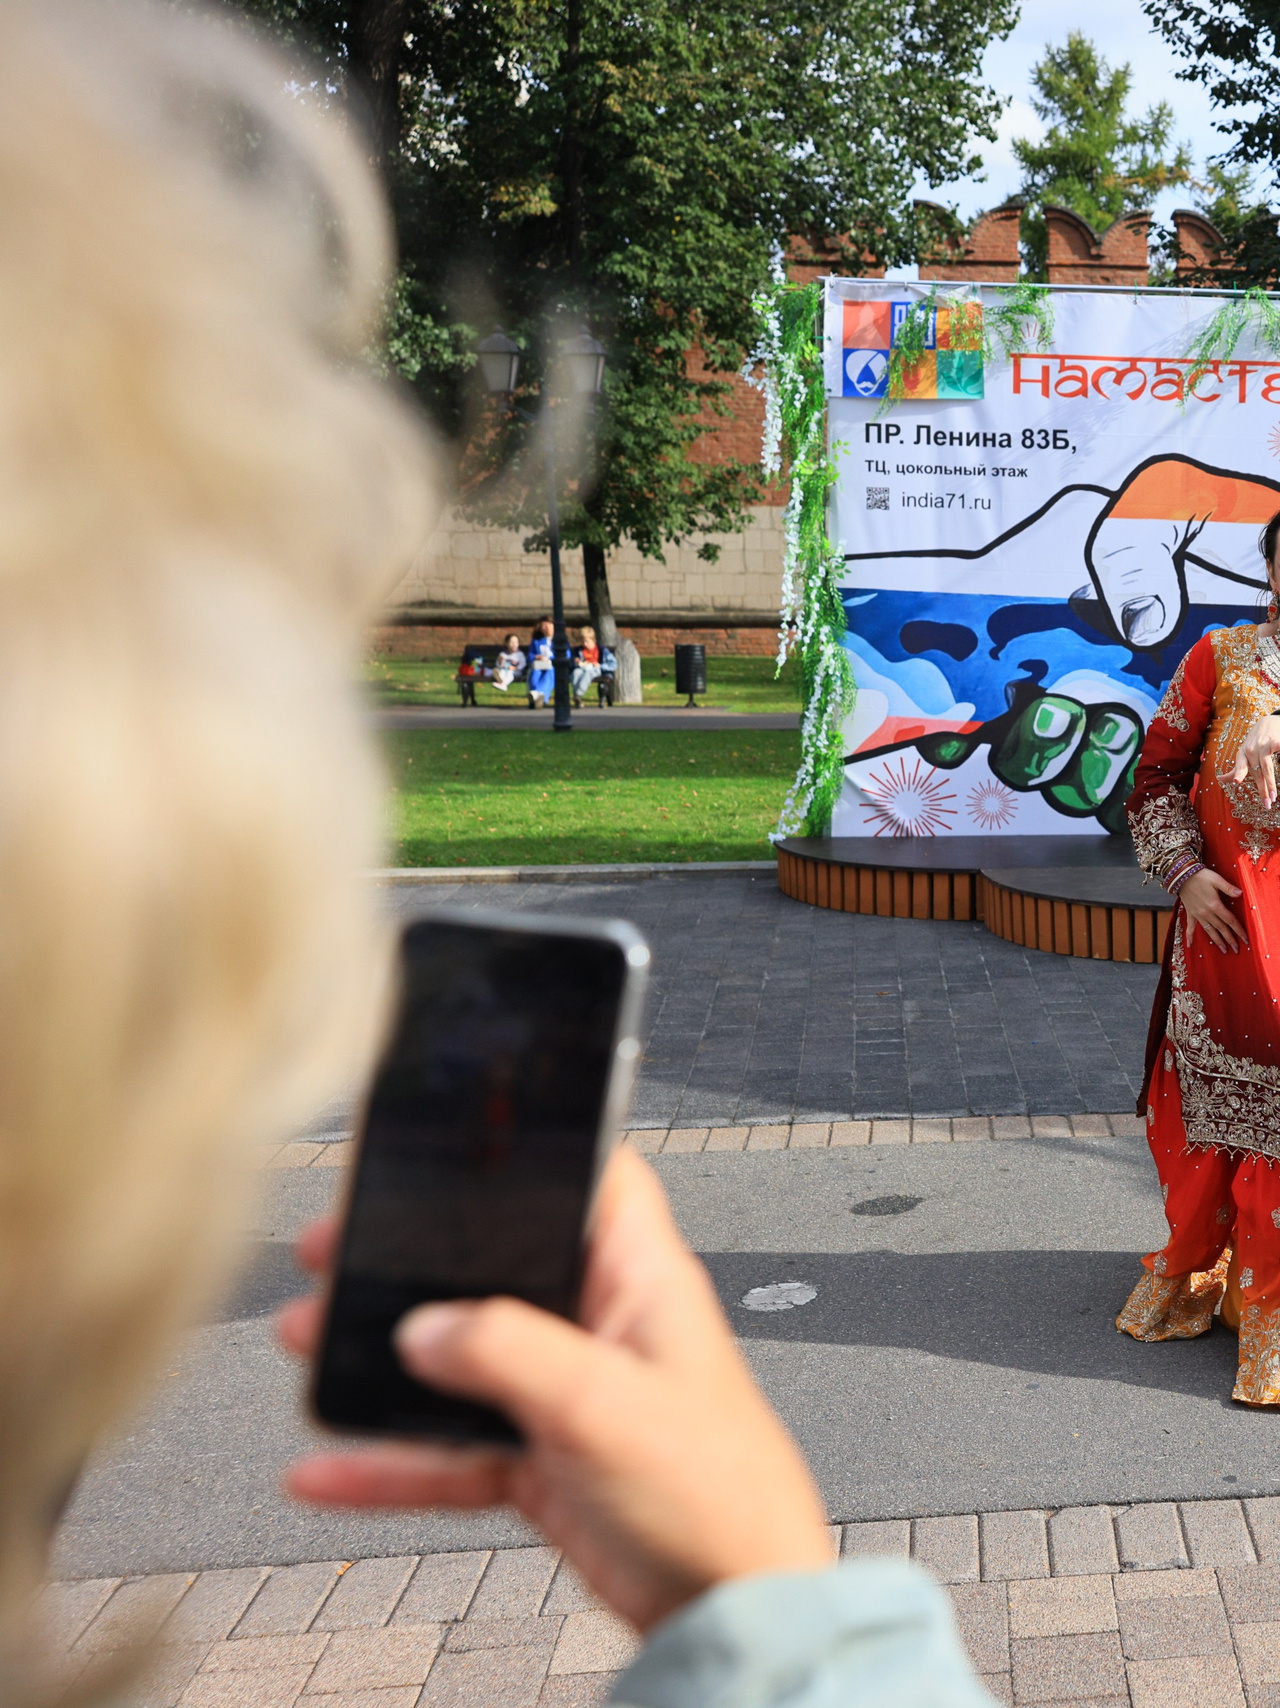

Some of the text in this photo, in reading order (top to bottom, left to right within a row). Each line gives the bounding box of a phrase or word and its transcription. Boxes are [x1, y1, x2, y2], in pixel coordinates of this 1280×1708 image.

[865, 422, 1077, 454] ПР. Ленина 83Б,
[865, 460, 1028, 477] ТЦ, цокольный этаж
[902, 491, 991, 510] india71.ru
